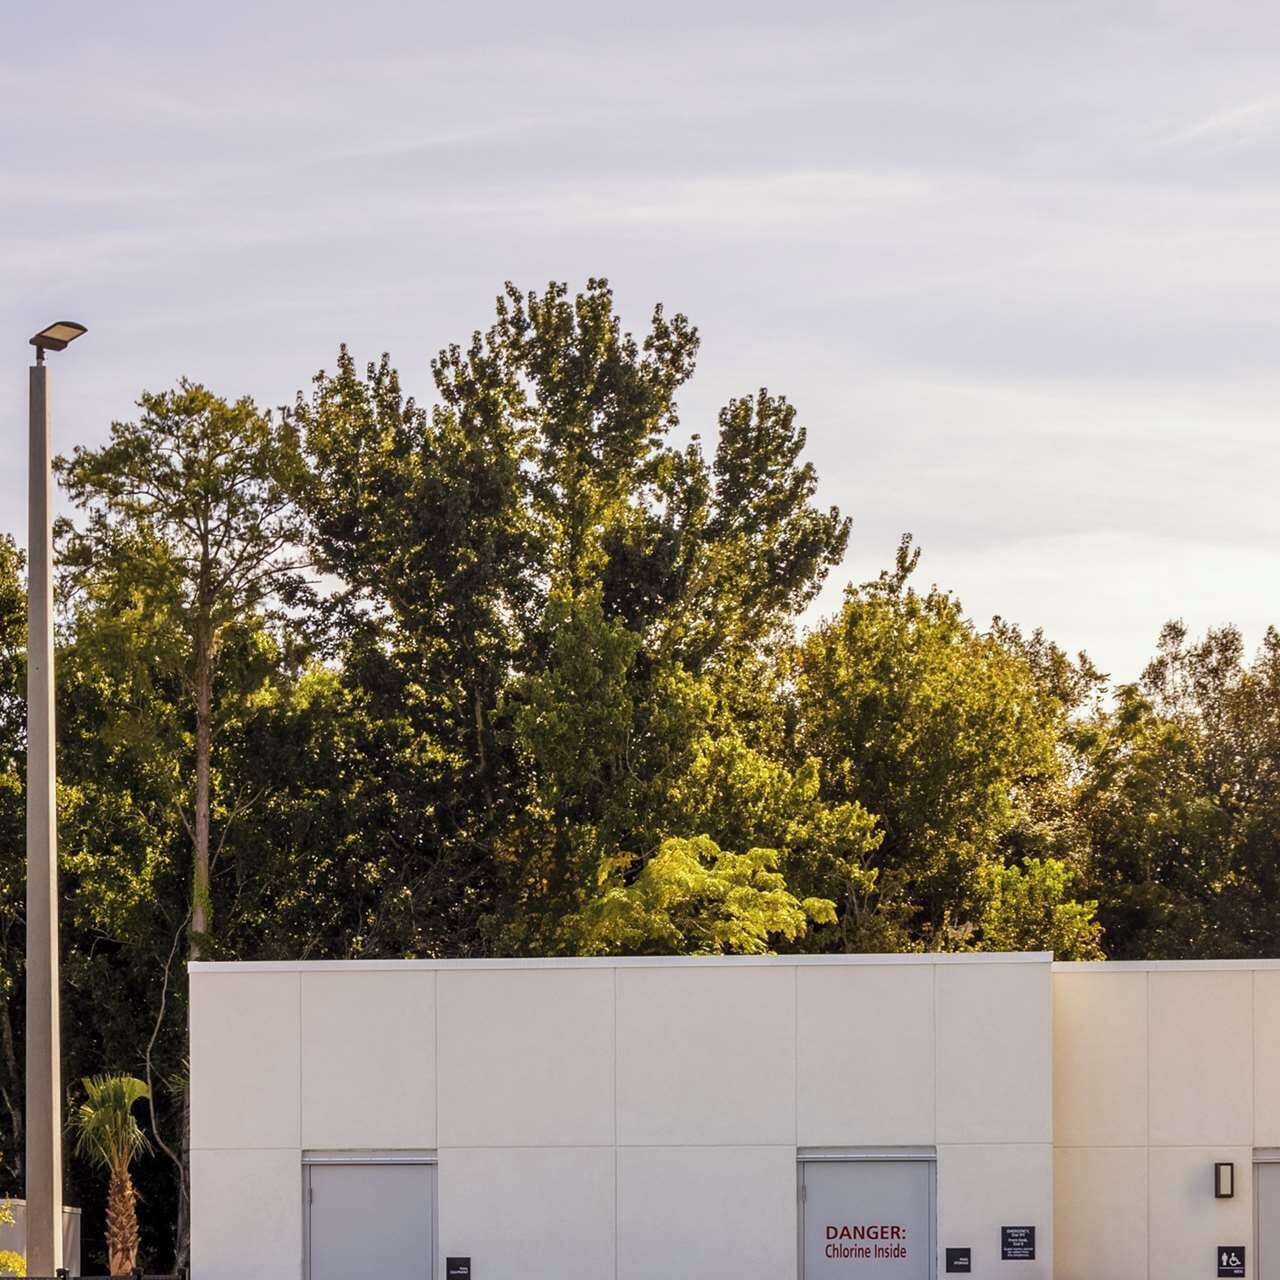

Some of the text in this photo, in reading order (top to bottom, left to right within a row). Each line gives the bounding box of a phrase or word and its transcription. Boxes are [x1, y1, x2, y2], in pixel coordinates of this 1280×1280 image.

[826, 1226, 906, 1240] DANGER:
[825, 1244, 907, 1258] Chlorine Inside
